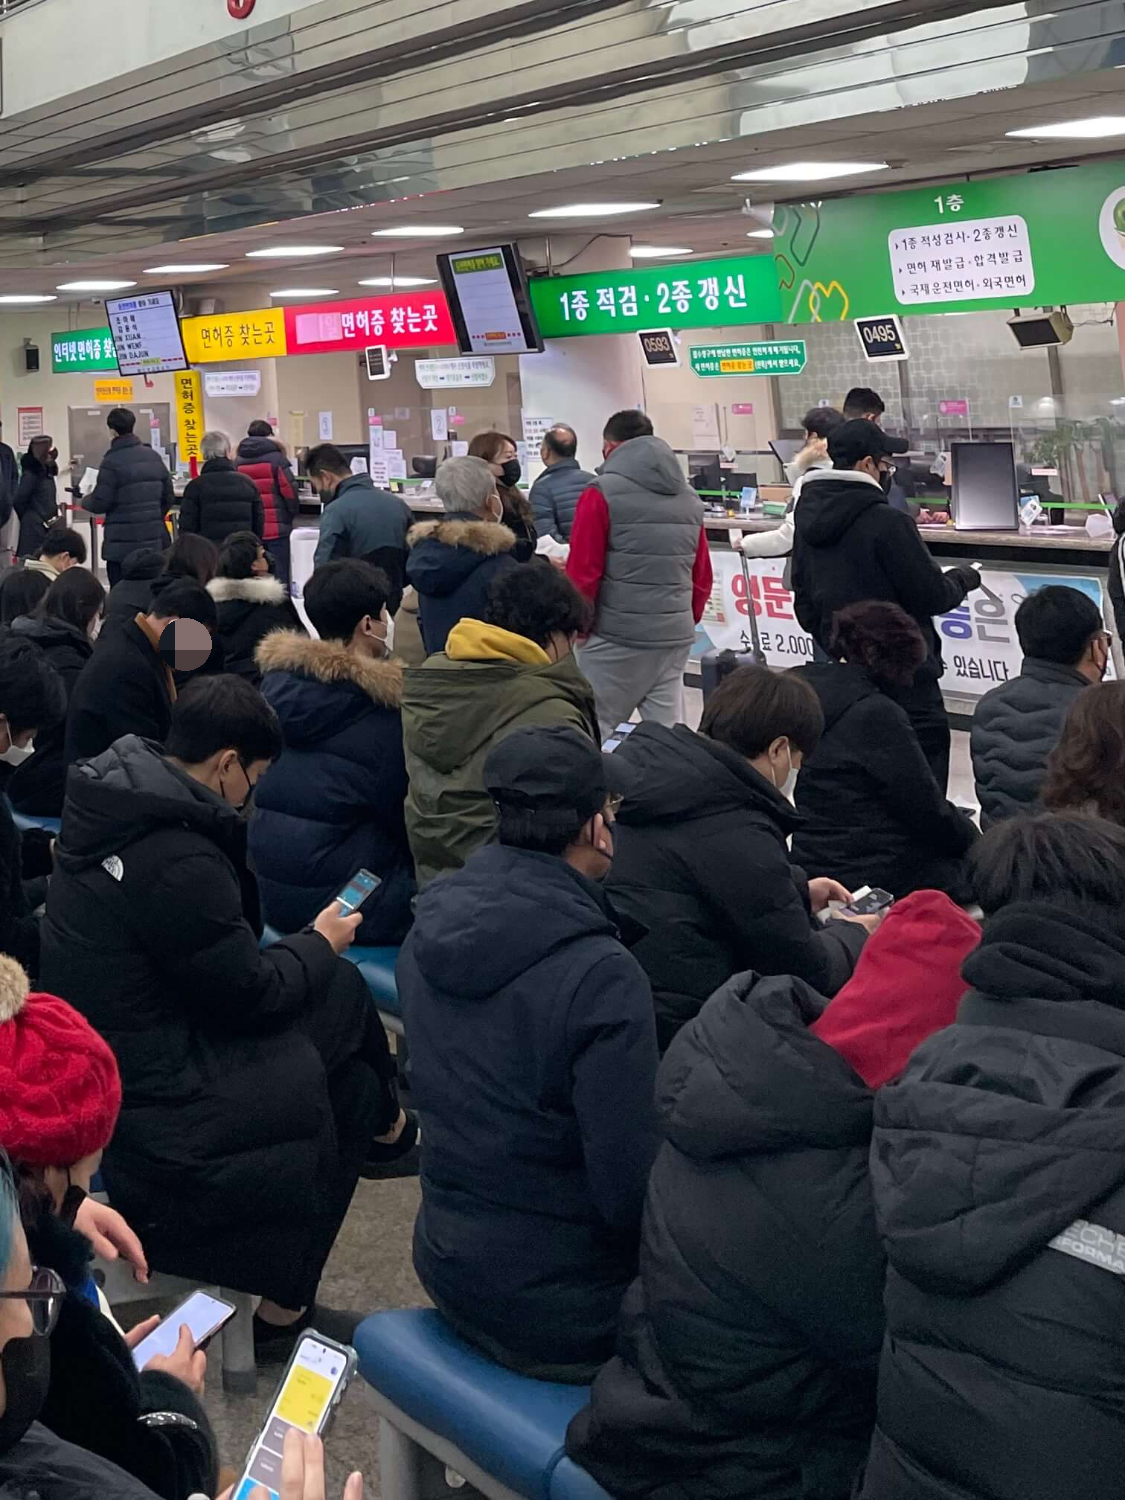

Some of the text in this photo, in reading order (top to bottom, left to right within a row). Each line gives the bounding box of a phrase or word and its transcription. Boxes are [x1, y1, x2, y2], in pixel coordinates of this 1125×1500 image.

[934, 193, 965, 214] 1층
[560, 290, 590, 321] 1종
[596, 285, 639, 317] 적검
[390, 304, 438, 334] 찾는곳
[201, 321, 275, 349] 면허증 찾는곳
[643, 336, 670, 352] 0593
[863, 324, 896, 344] 0495
[181, 378, 195, 414] 면허증
[731, 573, 795, 620] 영문
[740, 630, 772, 651] 수료
[953, 655, 1009, 682] 있습니다
